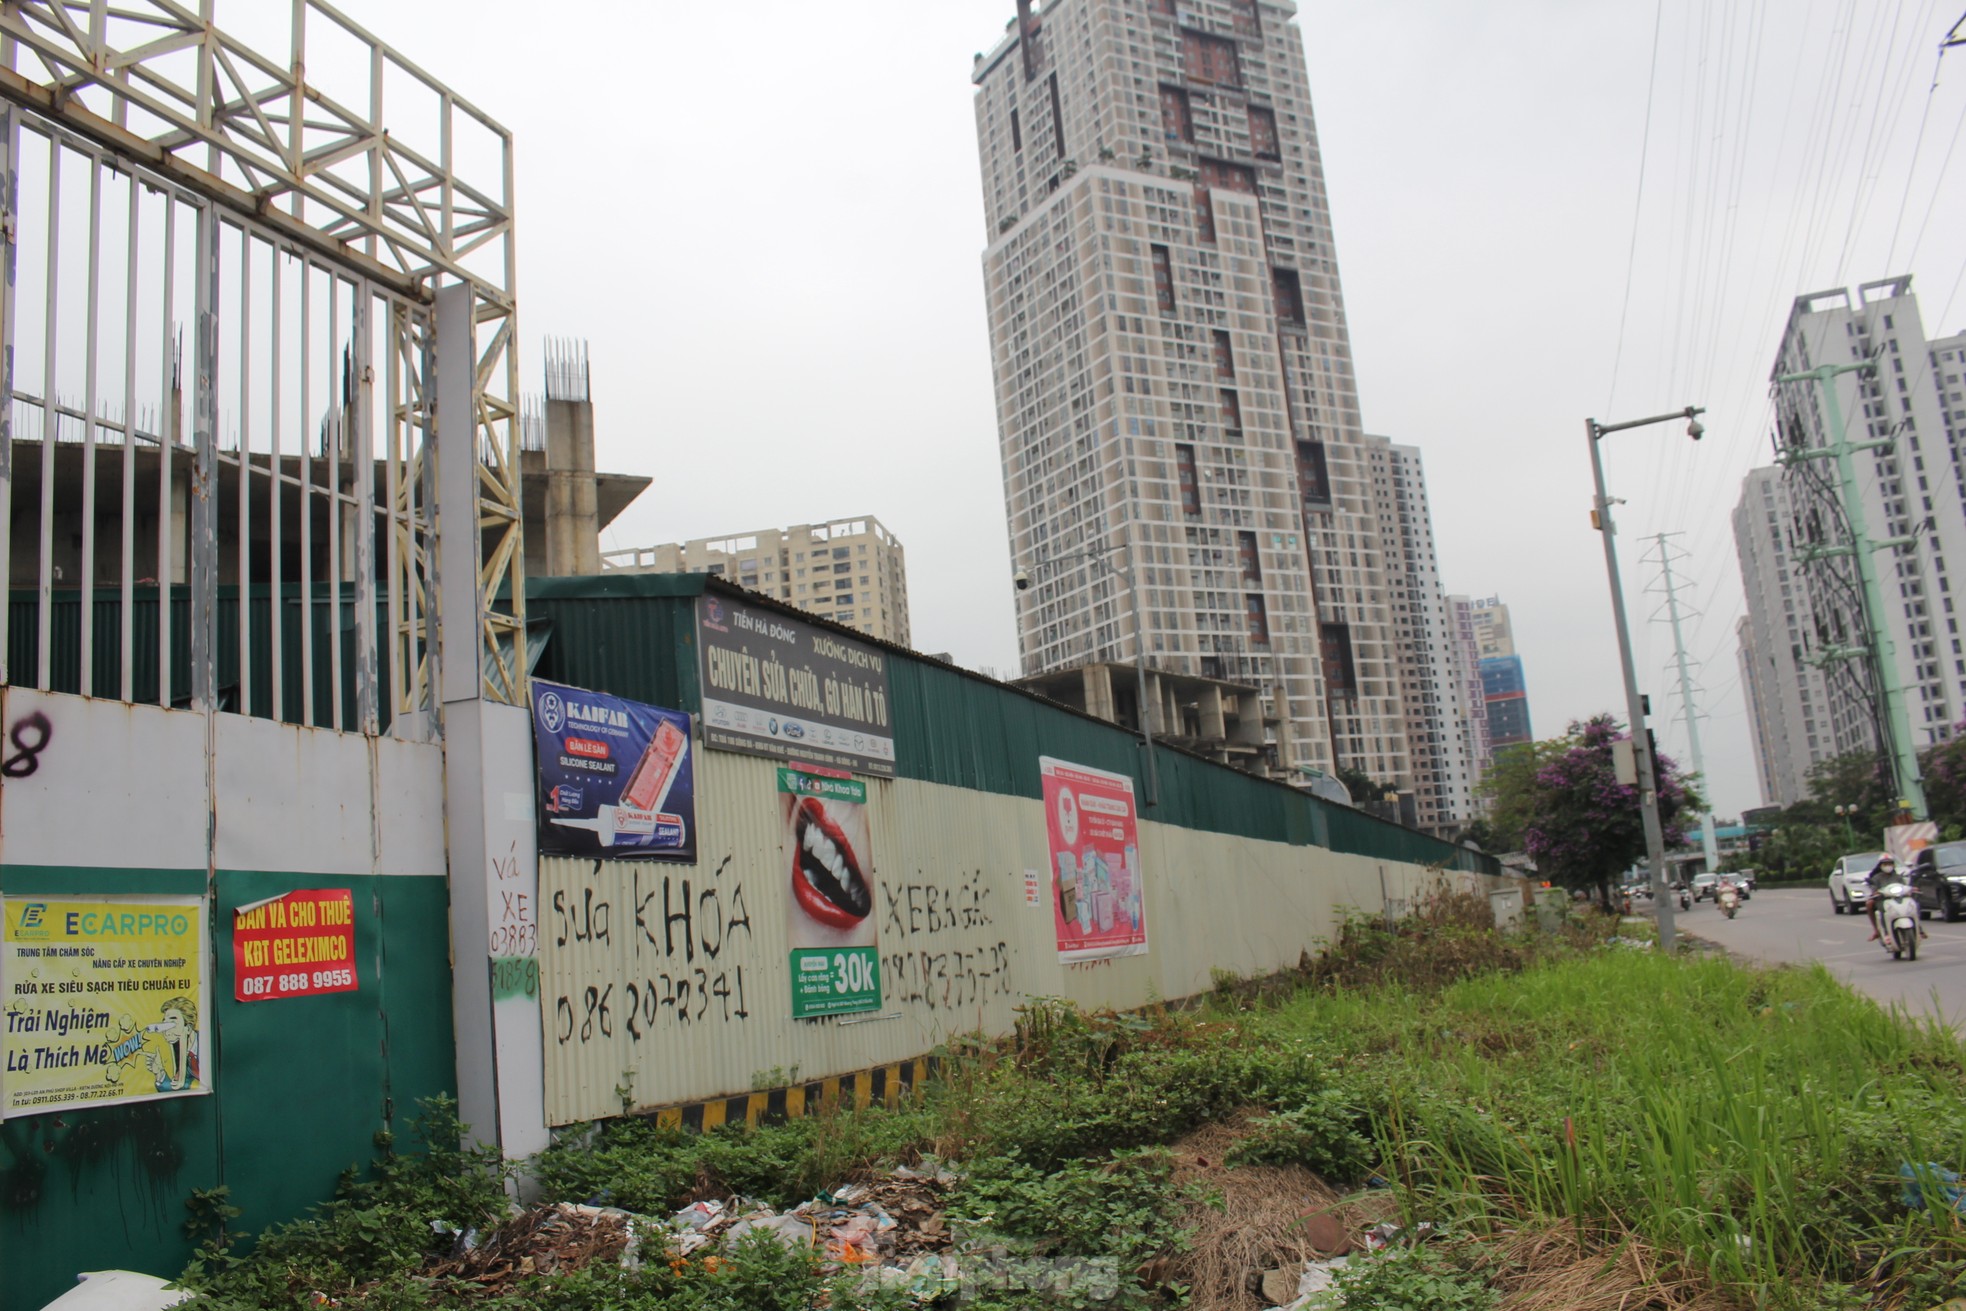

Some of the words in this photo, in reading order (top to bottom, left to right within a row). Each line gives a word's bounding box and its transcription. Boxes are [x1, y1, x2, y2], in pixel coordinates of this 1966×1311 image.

[733, 609, 754, 630] TIẾN
[755, 618, 768, 636] HÀ
[770, 627, 796, 644] ĐÔNG
[812, 635, 846, 662] XƯỞNG
[848, 648, 868, 668] DỊCH
[868, 655, 882, 675] VỤ
[708, 645, 761, 697] CHUYÊN
[762, 650, 788, 704] SỬA
[825, 671, 841, 716] GÒ
[841, 673, 864, 722] HÀN
[864, 682, 873, 724] Ô
[873, 686, 887, 728] TÔ
[568, 720, 600, 733] TECHNOLOGY
[601, 726, 608, 734] OF
[560, 756, 588, 769] SILICONE
[588, 761, 615, 772] SEALANT
[290, 901, 316, 928] CHO
[319, 894, 351, 926] THUÊ
[501, 890, 528, 922] XE
[66, 912, 188, 936] ECARPRO
[17, 948, 40, 957] TRUNG
[42, 946, 57, 957] TÂM
[81, 946, 95, 957] SÓC
[113, 957, 126, 968] CẤP
[128, 960, 136, 968] XE
[138, 957, 162, 968] CHUYÊN
[164, 958, 186, 969] NGHIỆP
[244, 940, 269, 967] KĐT
[273, 935, 347, 965] GELEXIMCO
[15, 980, 38, 994] RỬA
[41, 982, 55, 993] XE
[59, 979, 83, 992] SIÊU
[86, 981, 114, 994] SẠCH
[118, 978, 139, 992] TIÊU
[142, 976, 175, 990] CHUẨN
[178, 979, 190, 990] EU
[243, 976, 274, 995] 087
[279, 973, 308, 991] 888
[313, 969, 352, 988] 9955
[834, 952, 875, 994] 30k
[7, 1008, 41, 1033] Trải
[45, 1007, 109, 1036] Nghiệm
[7, 1045, 29, 1072] Là
[34, 1043, 79, 1069] Thích
[113, 1032, 142, 1062] WOW!
[32, 1093, 75, 1104] 0911.055.339
